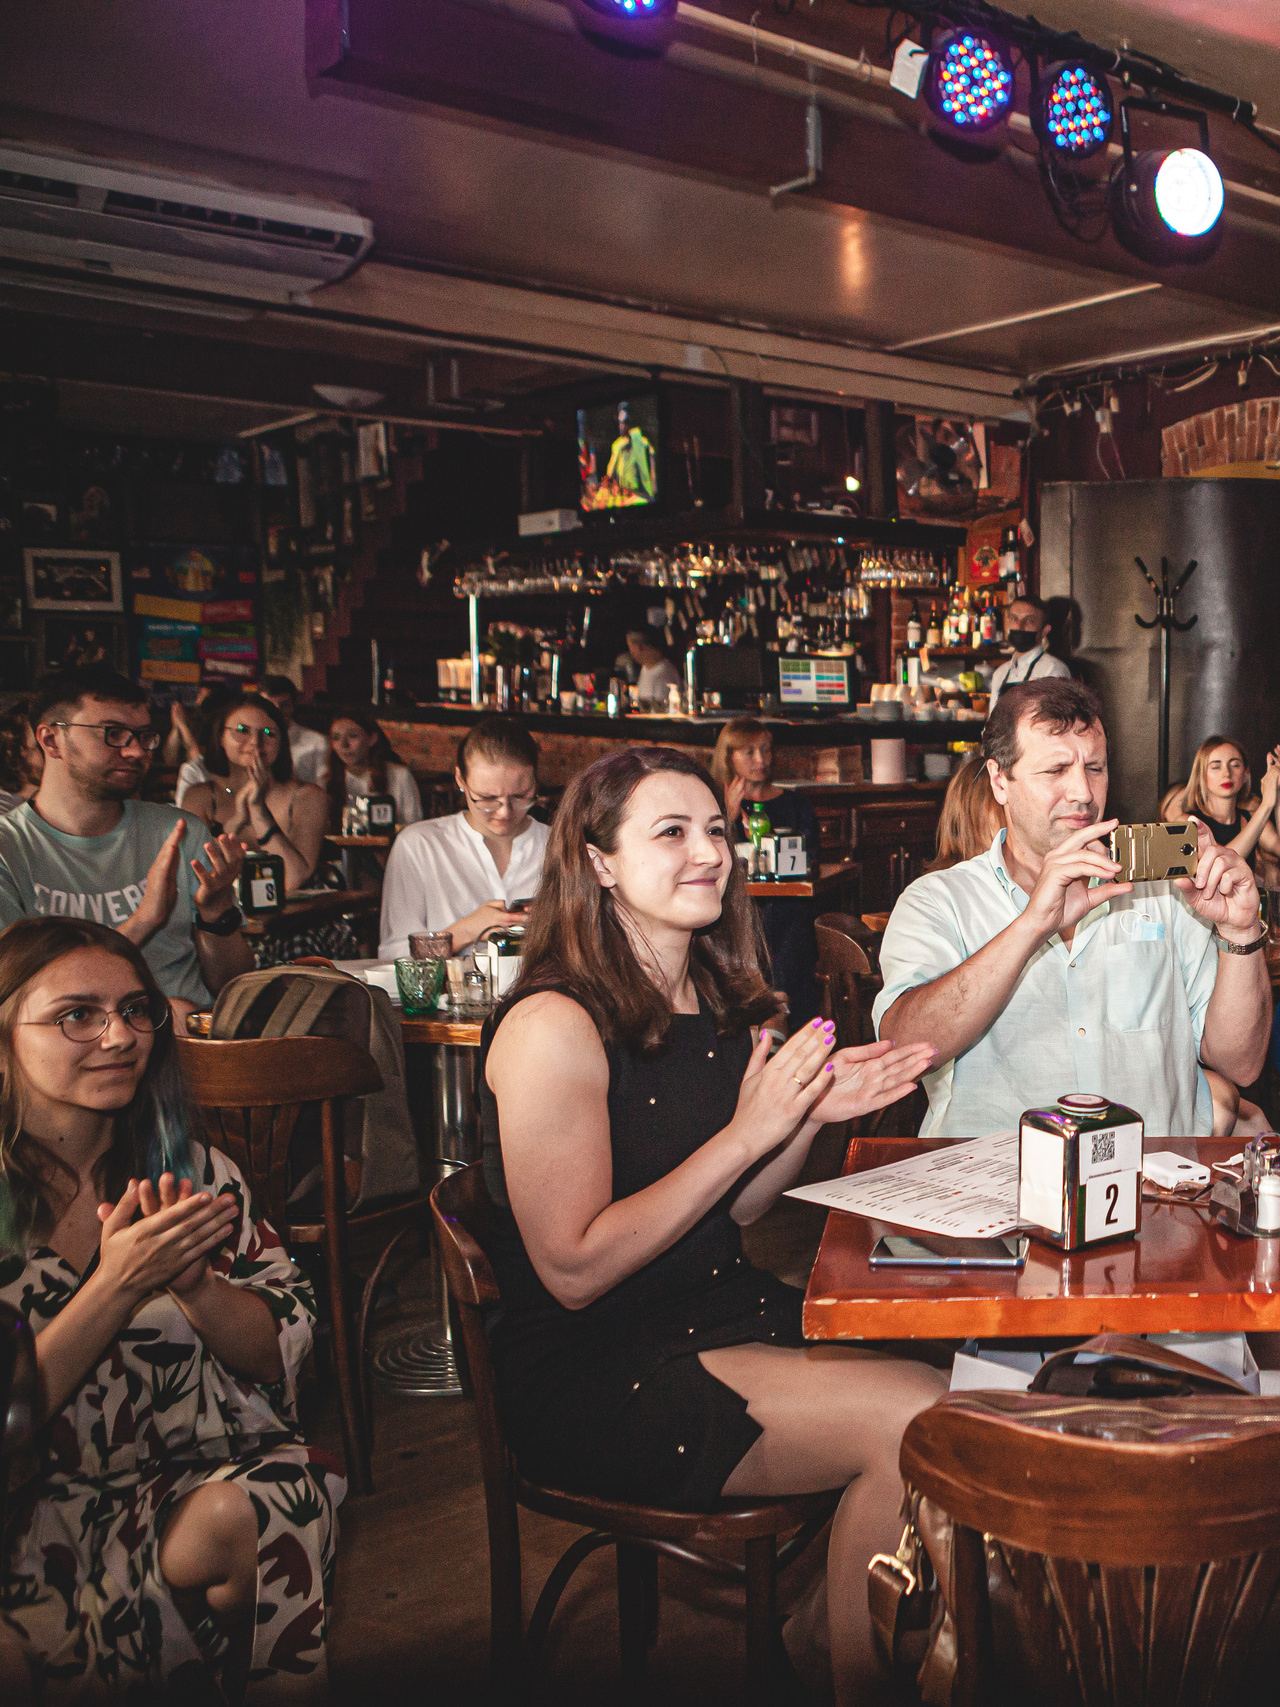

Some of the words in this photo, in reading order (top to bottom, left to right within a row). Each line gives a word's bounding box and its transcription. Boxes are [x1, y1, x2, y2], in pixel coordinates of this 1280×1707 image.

[790, 855, 796, 871] 7
[265, 882, 275, 901] 8
[1105, 1183, 1119, 1226] 2
